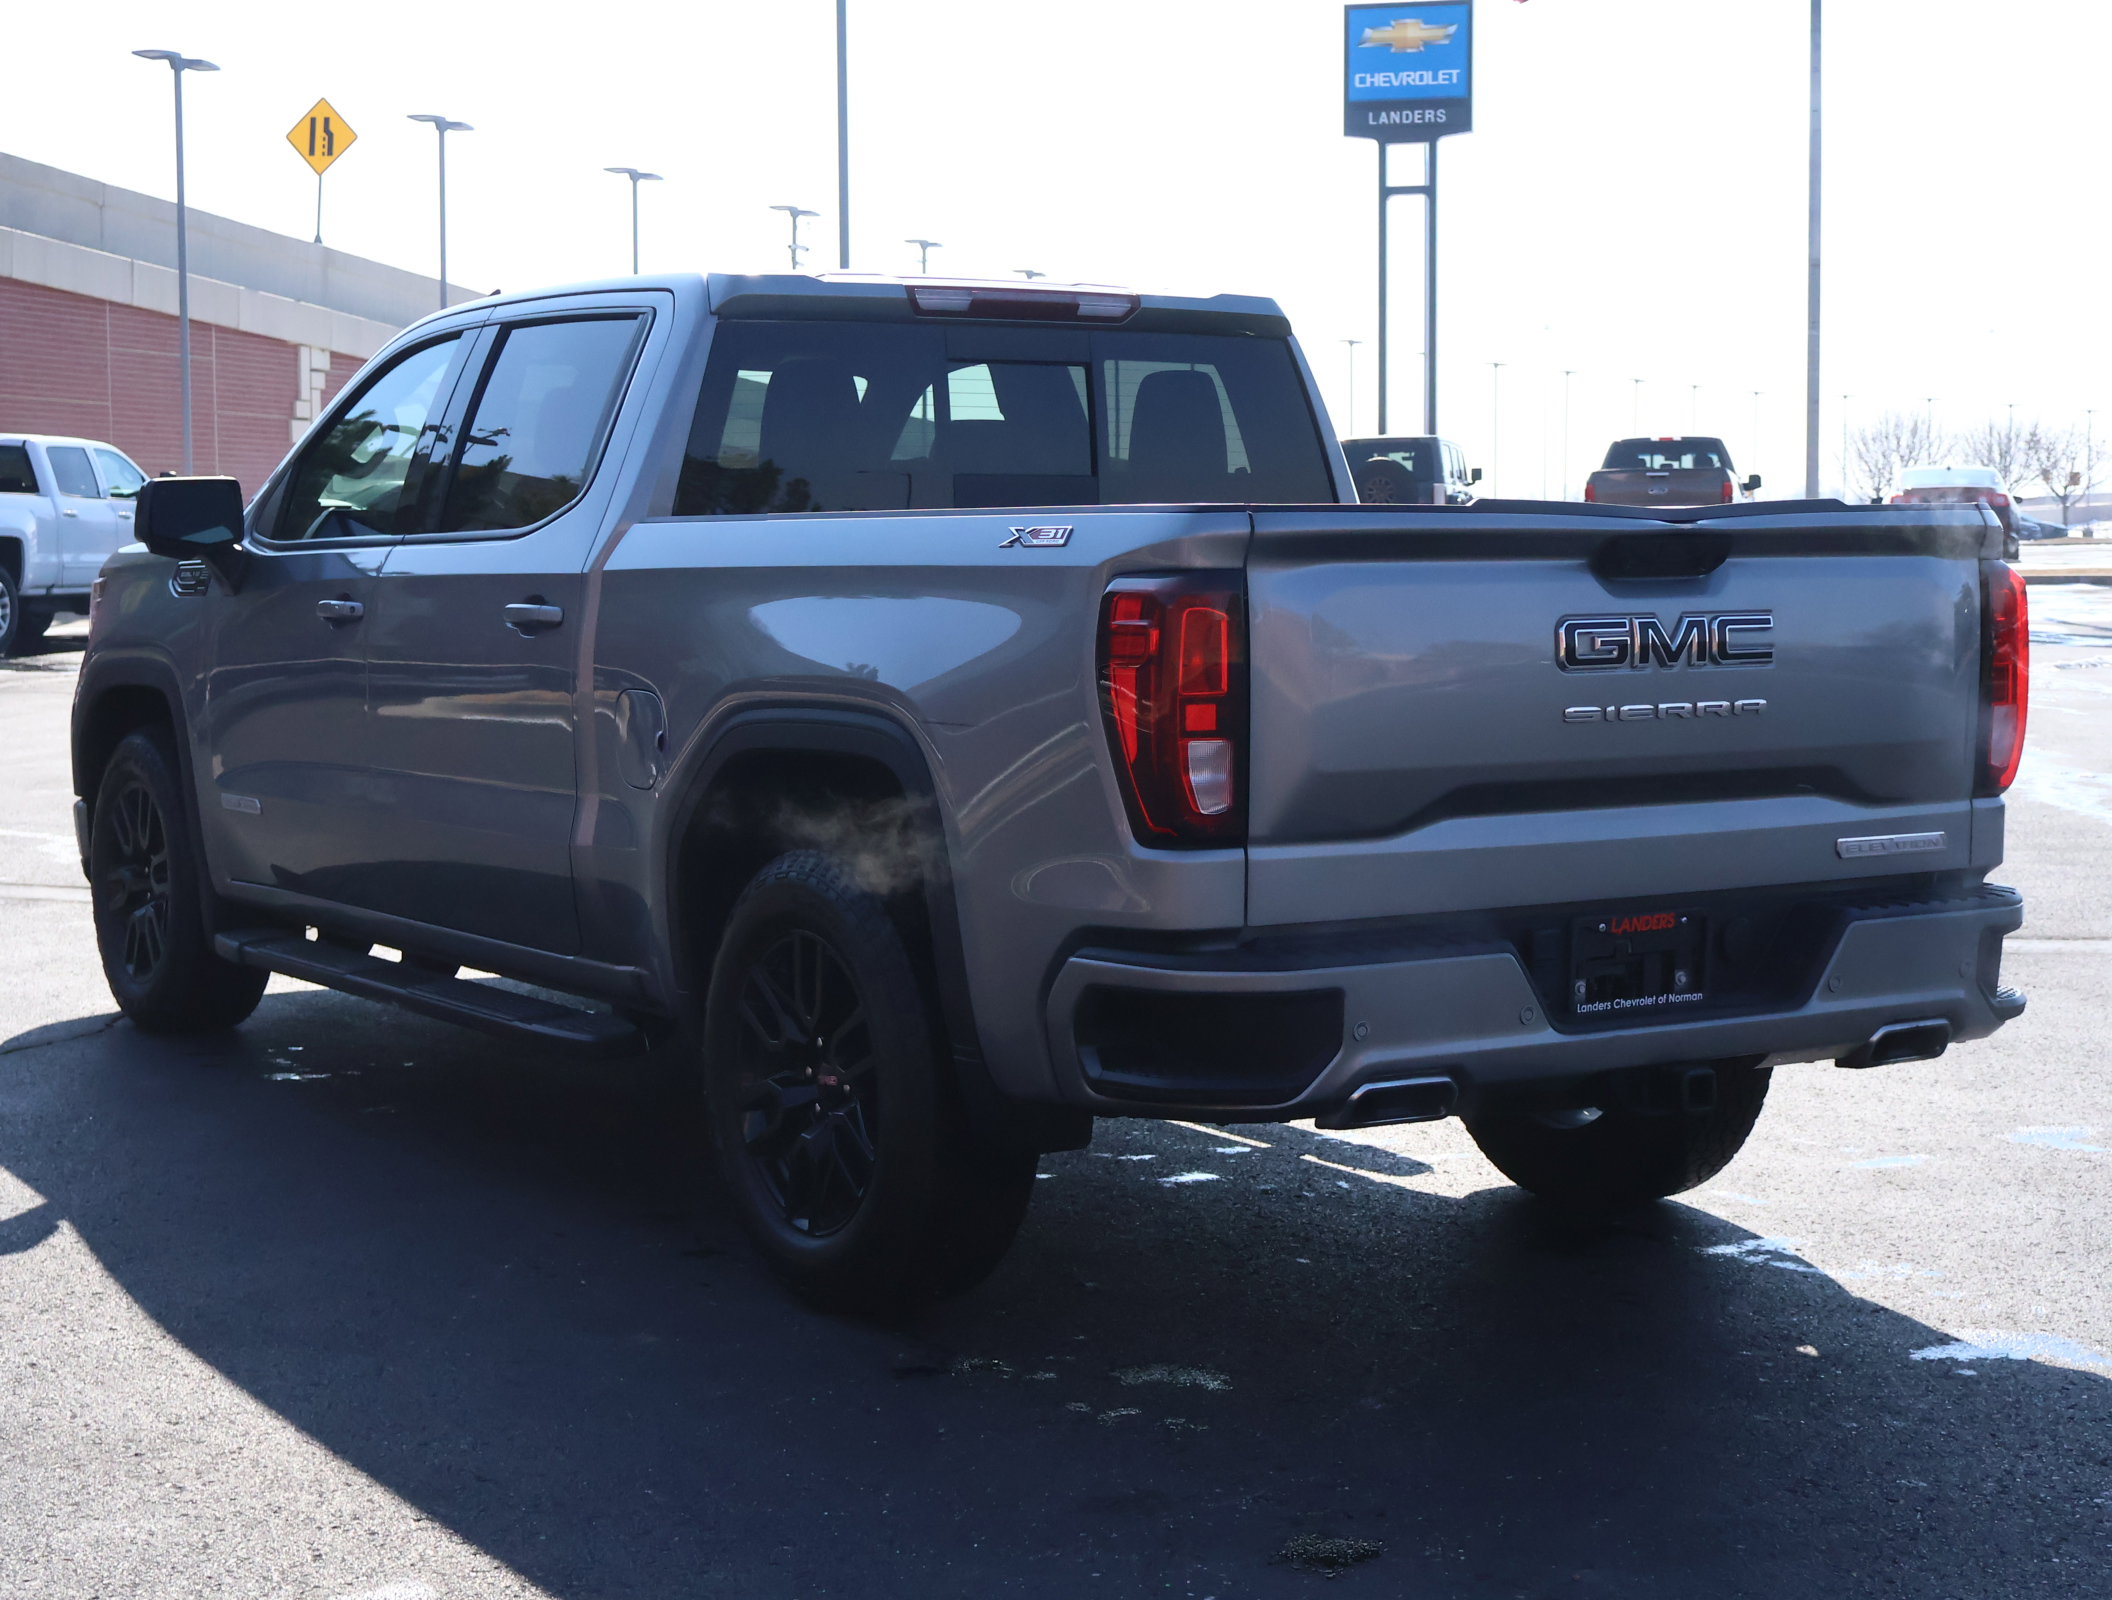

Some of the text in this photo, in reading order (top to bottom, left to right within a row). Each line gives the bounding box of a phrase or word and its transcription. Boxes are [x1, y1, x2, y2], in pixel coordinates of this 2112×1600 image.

[1354, 69, 1461, 88] CHEVROLET
[1368, 108, 1447, 125] LANDERS
[998, 525, 1074, 547] X31
[1555, 609, 1775, 673] GMC
[1563, 698, 1768, 723] SIERRA
[1610, 912, 1677, 935] LANDERS
[1577, 992, 1703, 1013] Landers Chevrolet of Norman
